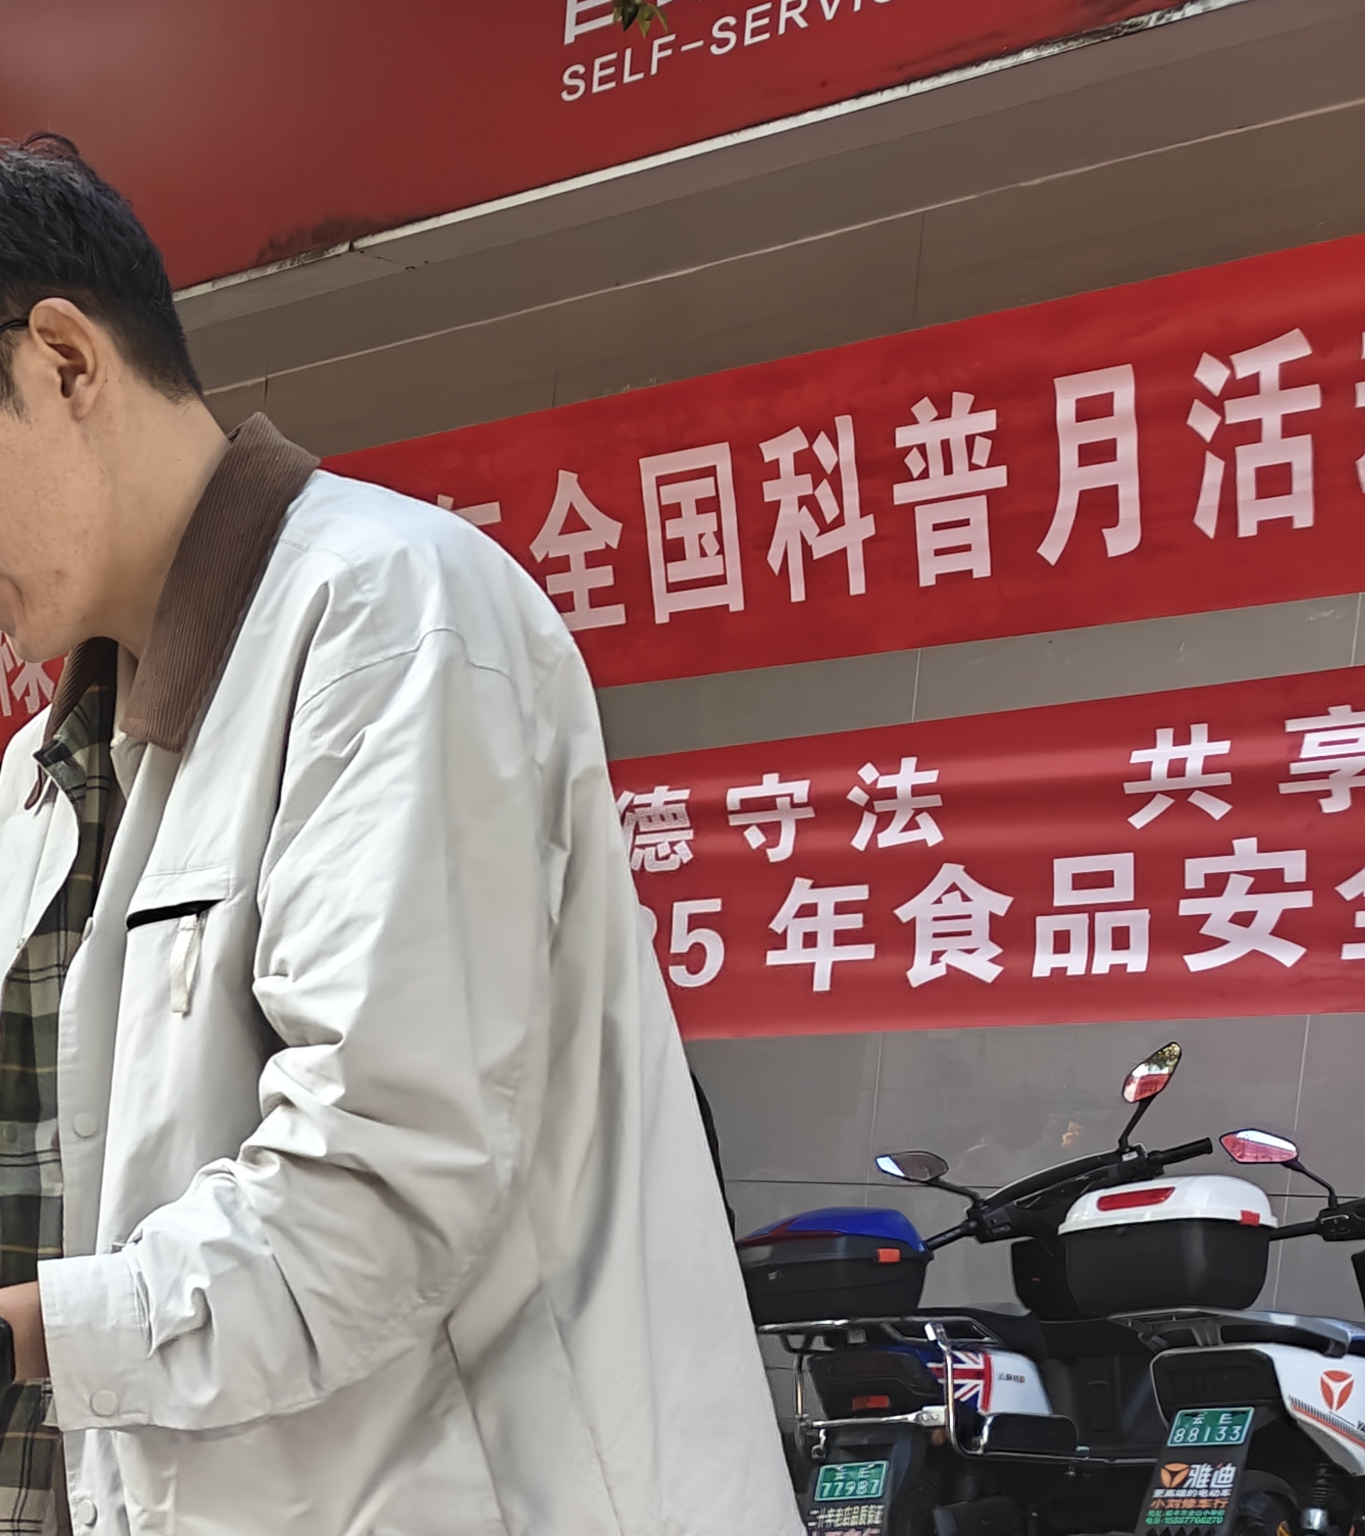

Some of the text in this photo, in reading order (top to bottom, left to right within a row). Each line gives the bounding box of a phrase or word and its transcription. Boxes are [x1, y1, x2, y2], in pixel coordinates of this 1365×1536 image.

[560, 0, 893, 101] SELF-SERV
[435, 327, 1365, 632] 全国科普月活
[617, 704, 1365, 873] 德守法 共享
[641, 837, 1365, 993] 5年食品安
[1173, 1425, 1243, 1443] 88133
[1182, 1462, 1238, 1489] 雅迪
[820, 1479, 882, 1498] 77987
